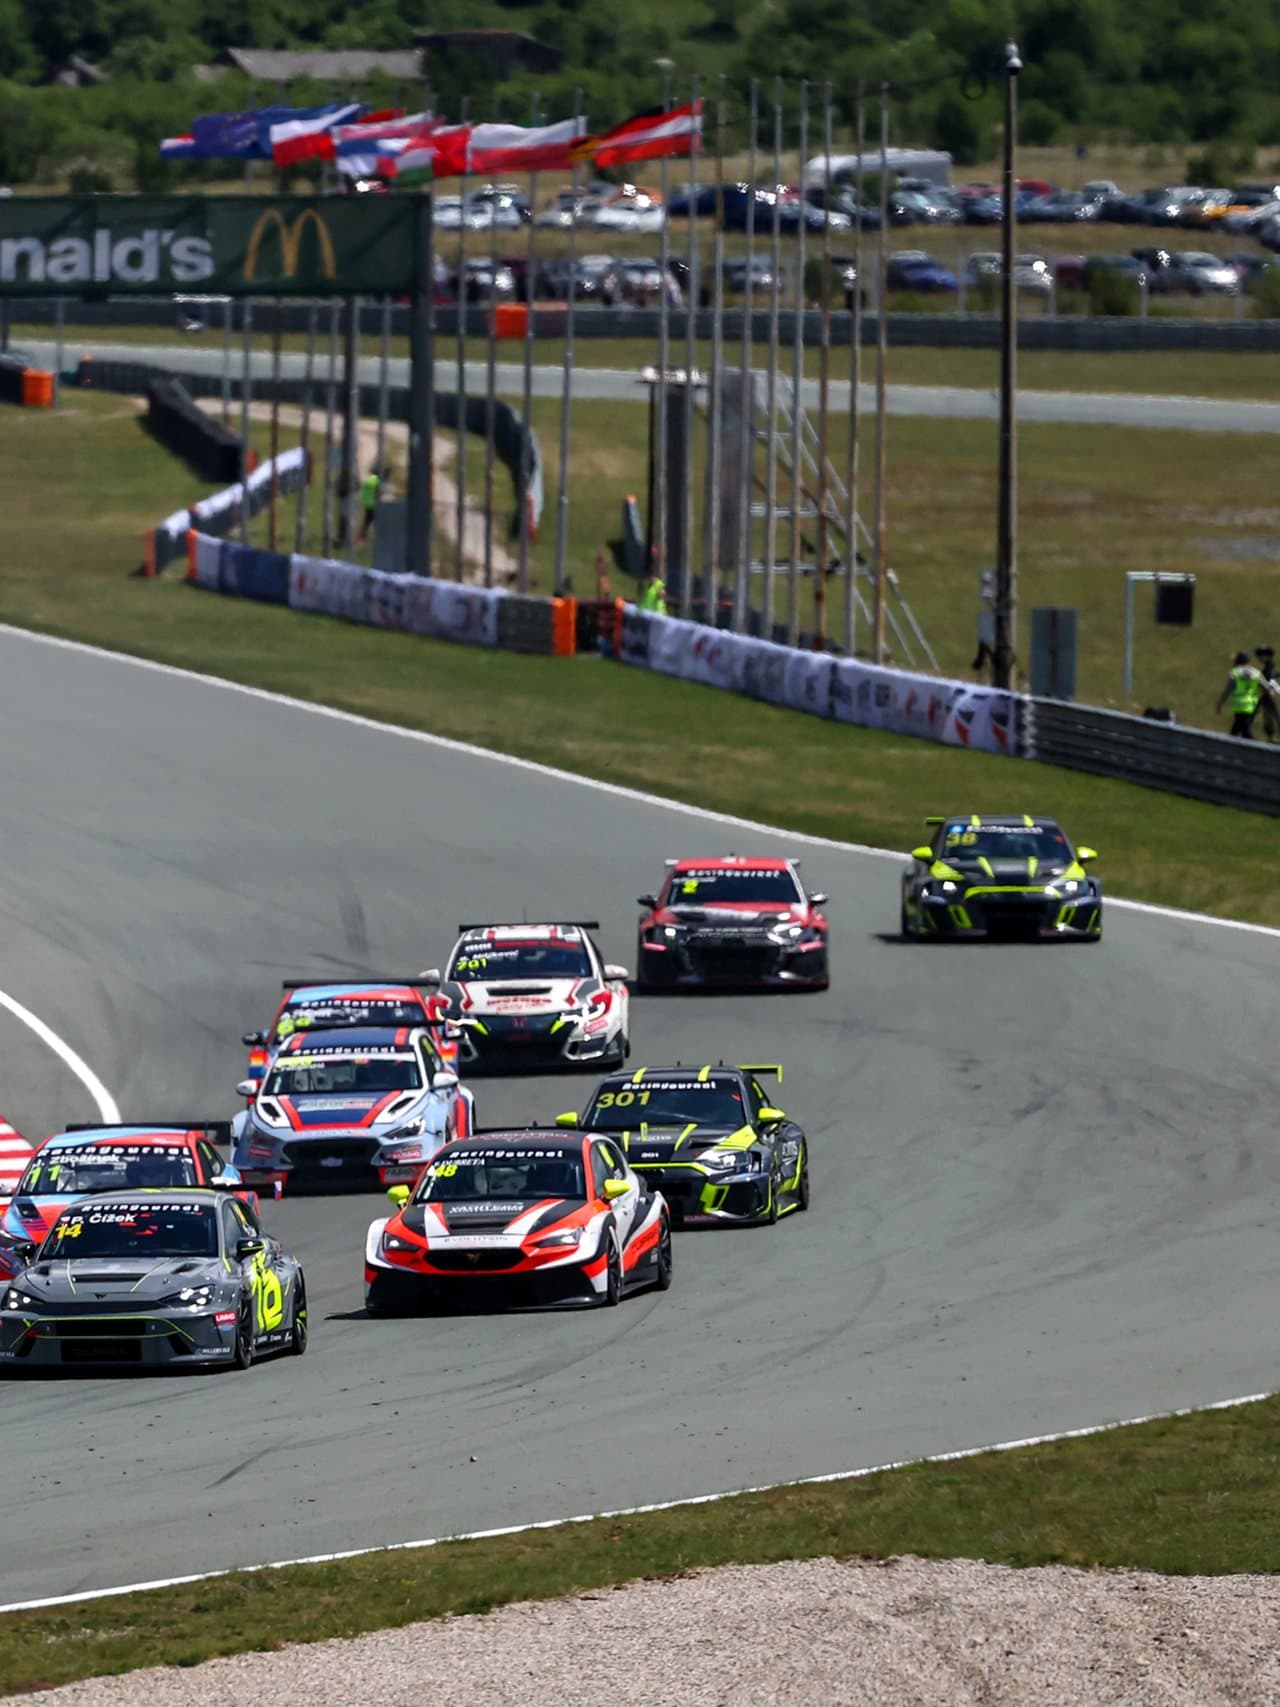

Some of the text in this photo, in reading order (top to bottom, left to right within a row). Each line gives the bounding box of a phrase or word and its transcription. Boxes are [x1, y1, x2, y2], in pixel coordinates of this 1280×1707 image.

[596, 1091, 651, 1108] 301
[434, 1164, 458, 1178] 48
[55, 1223, 82, 1240] 14
